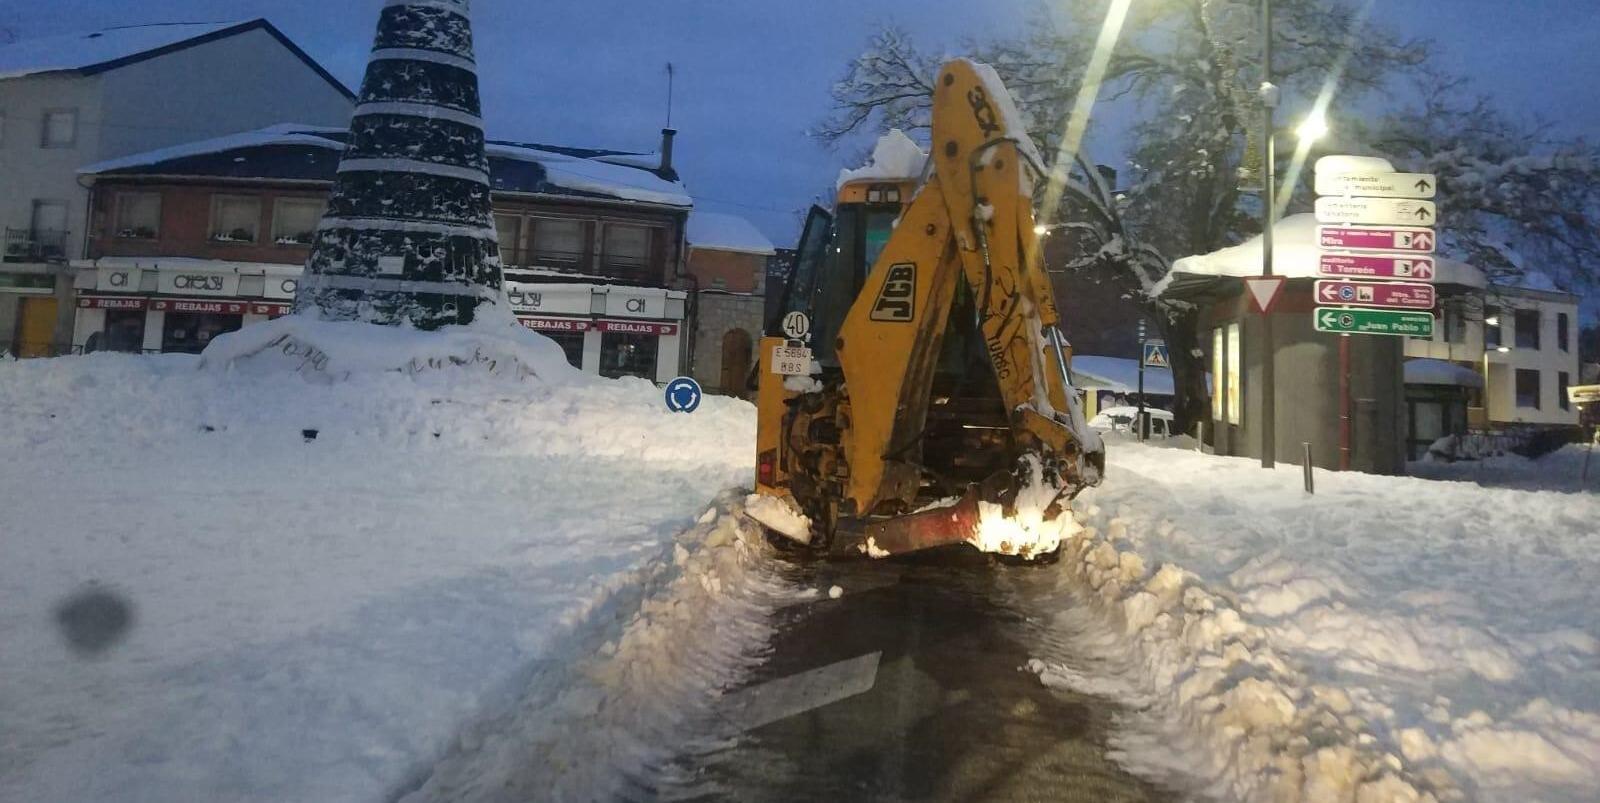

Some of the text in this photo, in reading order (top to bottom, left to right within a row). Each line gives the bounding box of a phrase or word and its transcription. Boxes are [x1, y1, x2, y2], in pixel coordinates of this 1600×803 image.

[1322, 264, 1376, 274] El Torreón
[875, 266, 914, 318] JCB
[97, 299, 141, 309] REBAJAS
[174, 302, 222, 313] REBAJAS
[522, 319, 572, 331] REBAJAS
[606, 322, 653, 334] REBAJAS
[786, 314, 805, 335] 40
[1367, 321, 1388, 330] Juan
[1392, 322, 1419, 331] Pablo
